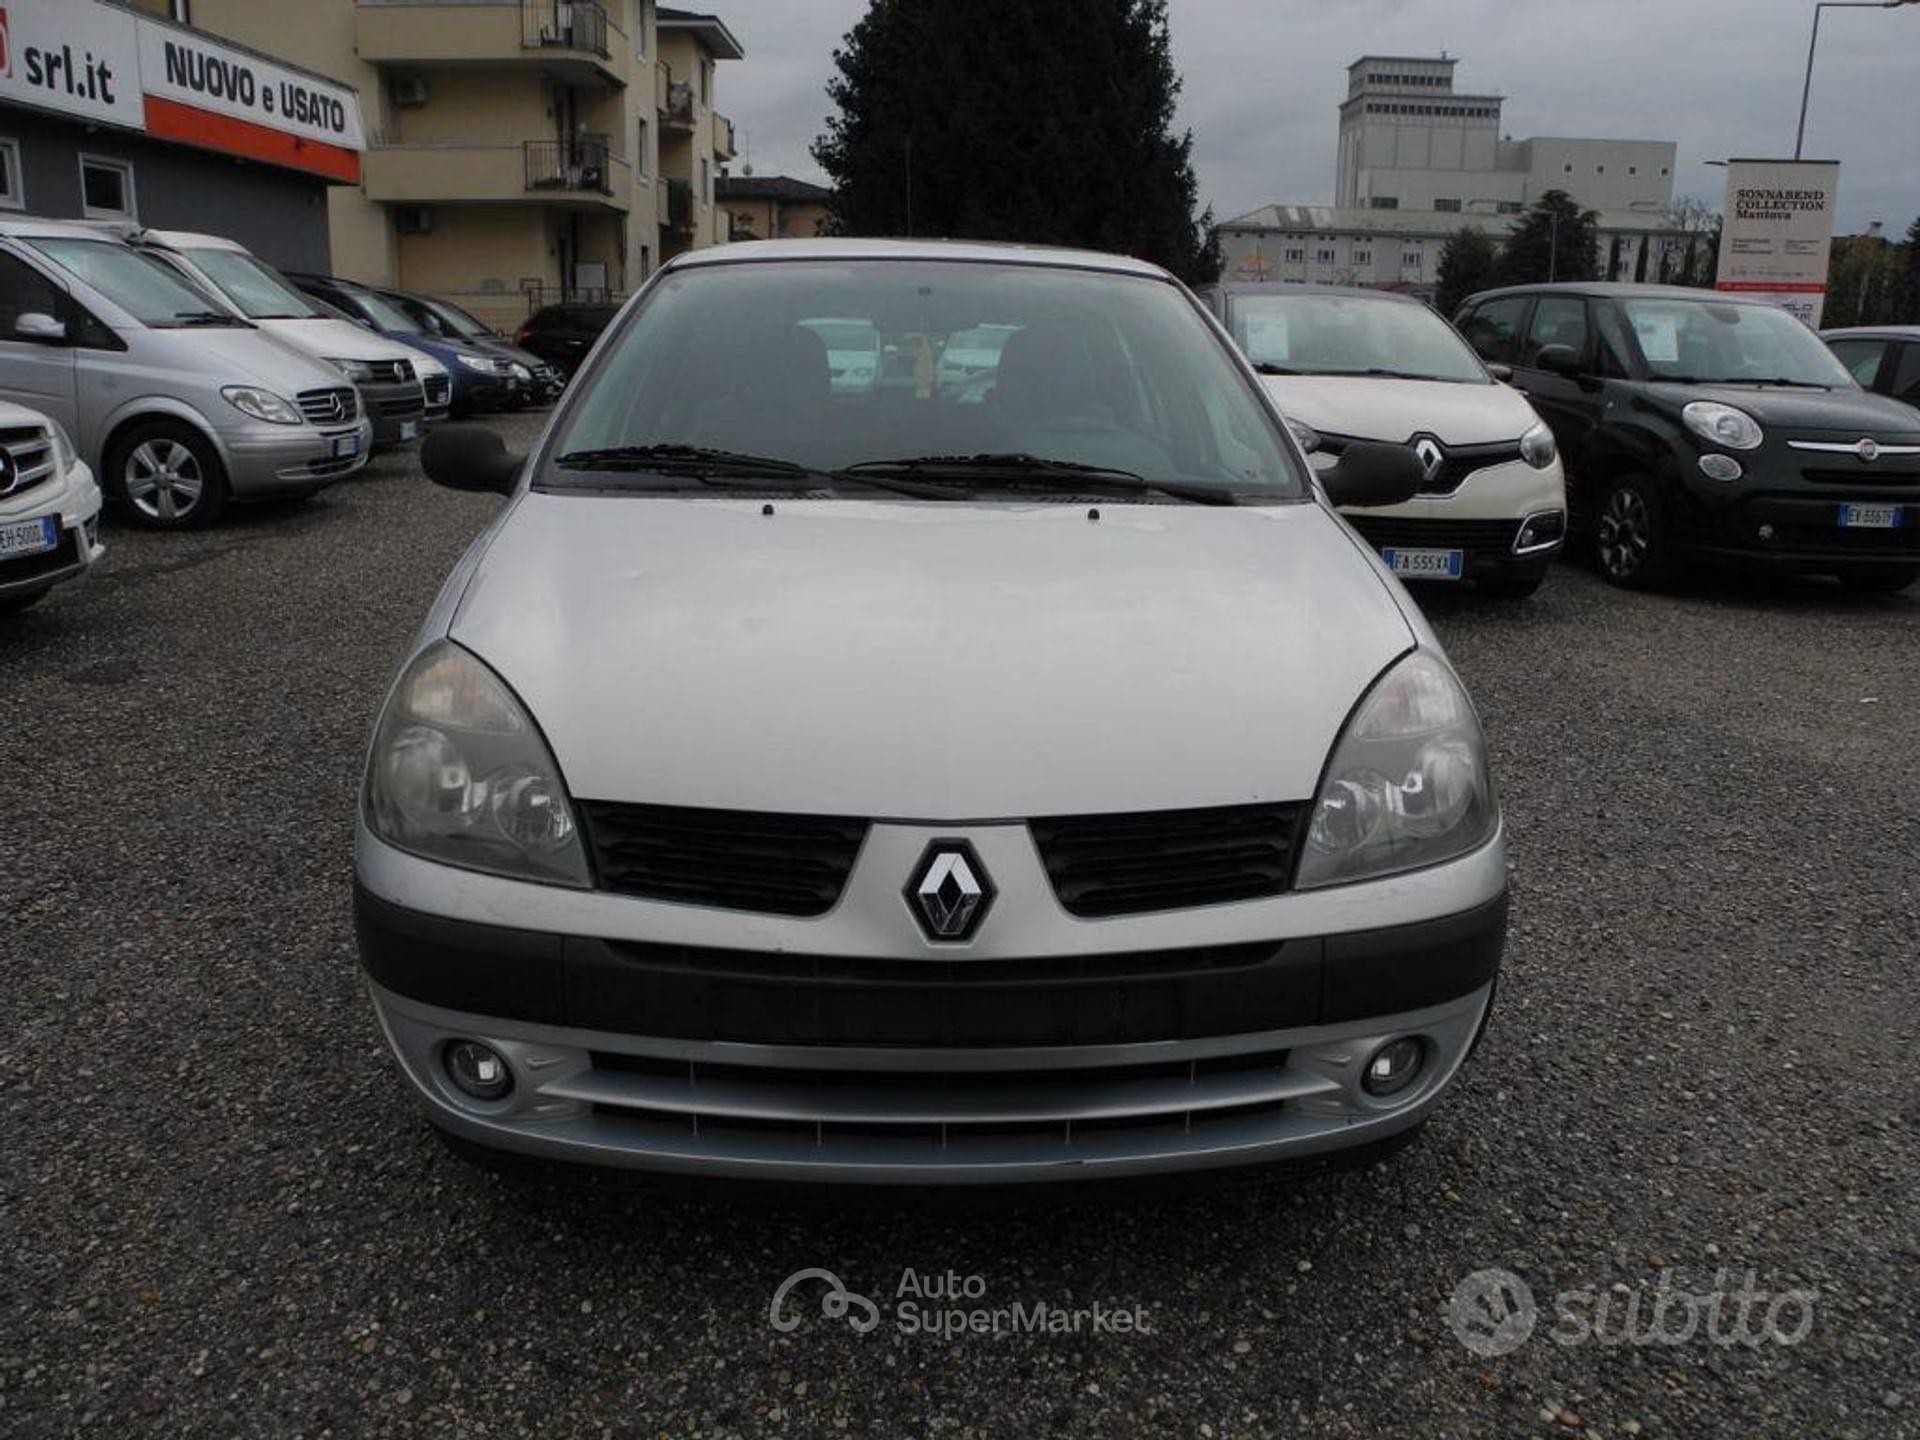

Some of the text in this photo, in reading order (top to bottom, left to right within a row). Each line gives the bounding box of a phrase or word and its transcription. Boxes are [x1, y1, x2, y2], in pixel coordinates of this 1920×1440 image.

[24, 45, 116, 104] srl.it
[165, 41, 345, 133] NUOVO e USATO
[1736, 189, 1825, 200] SONNABEND
[1736, 200, 1825, 211] COLLECTION
[1736, 210, 1792, 220] Mantova
